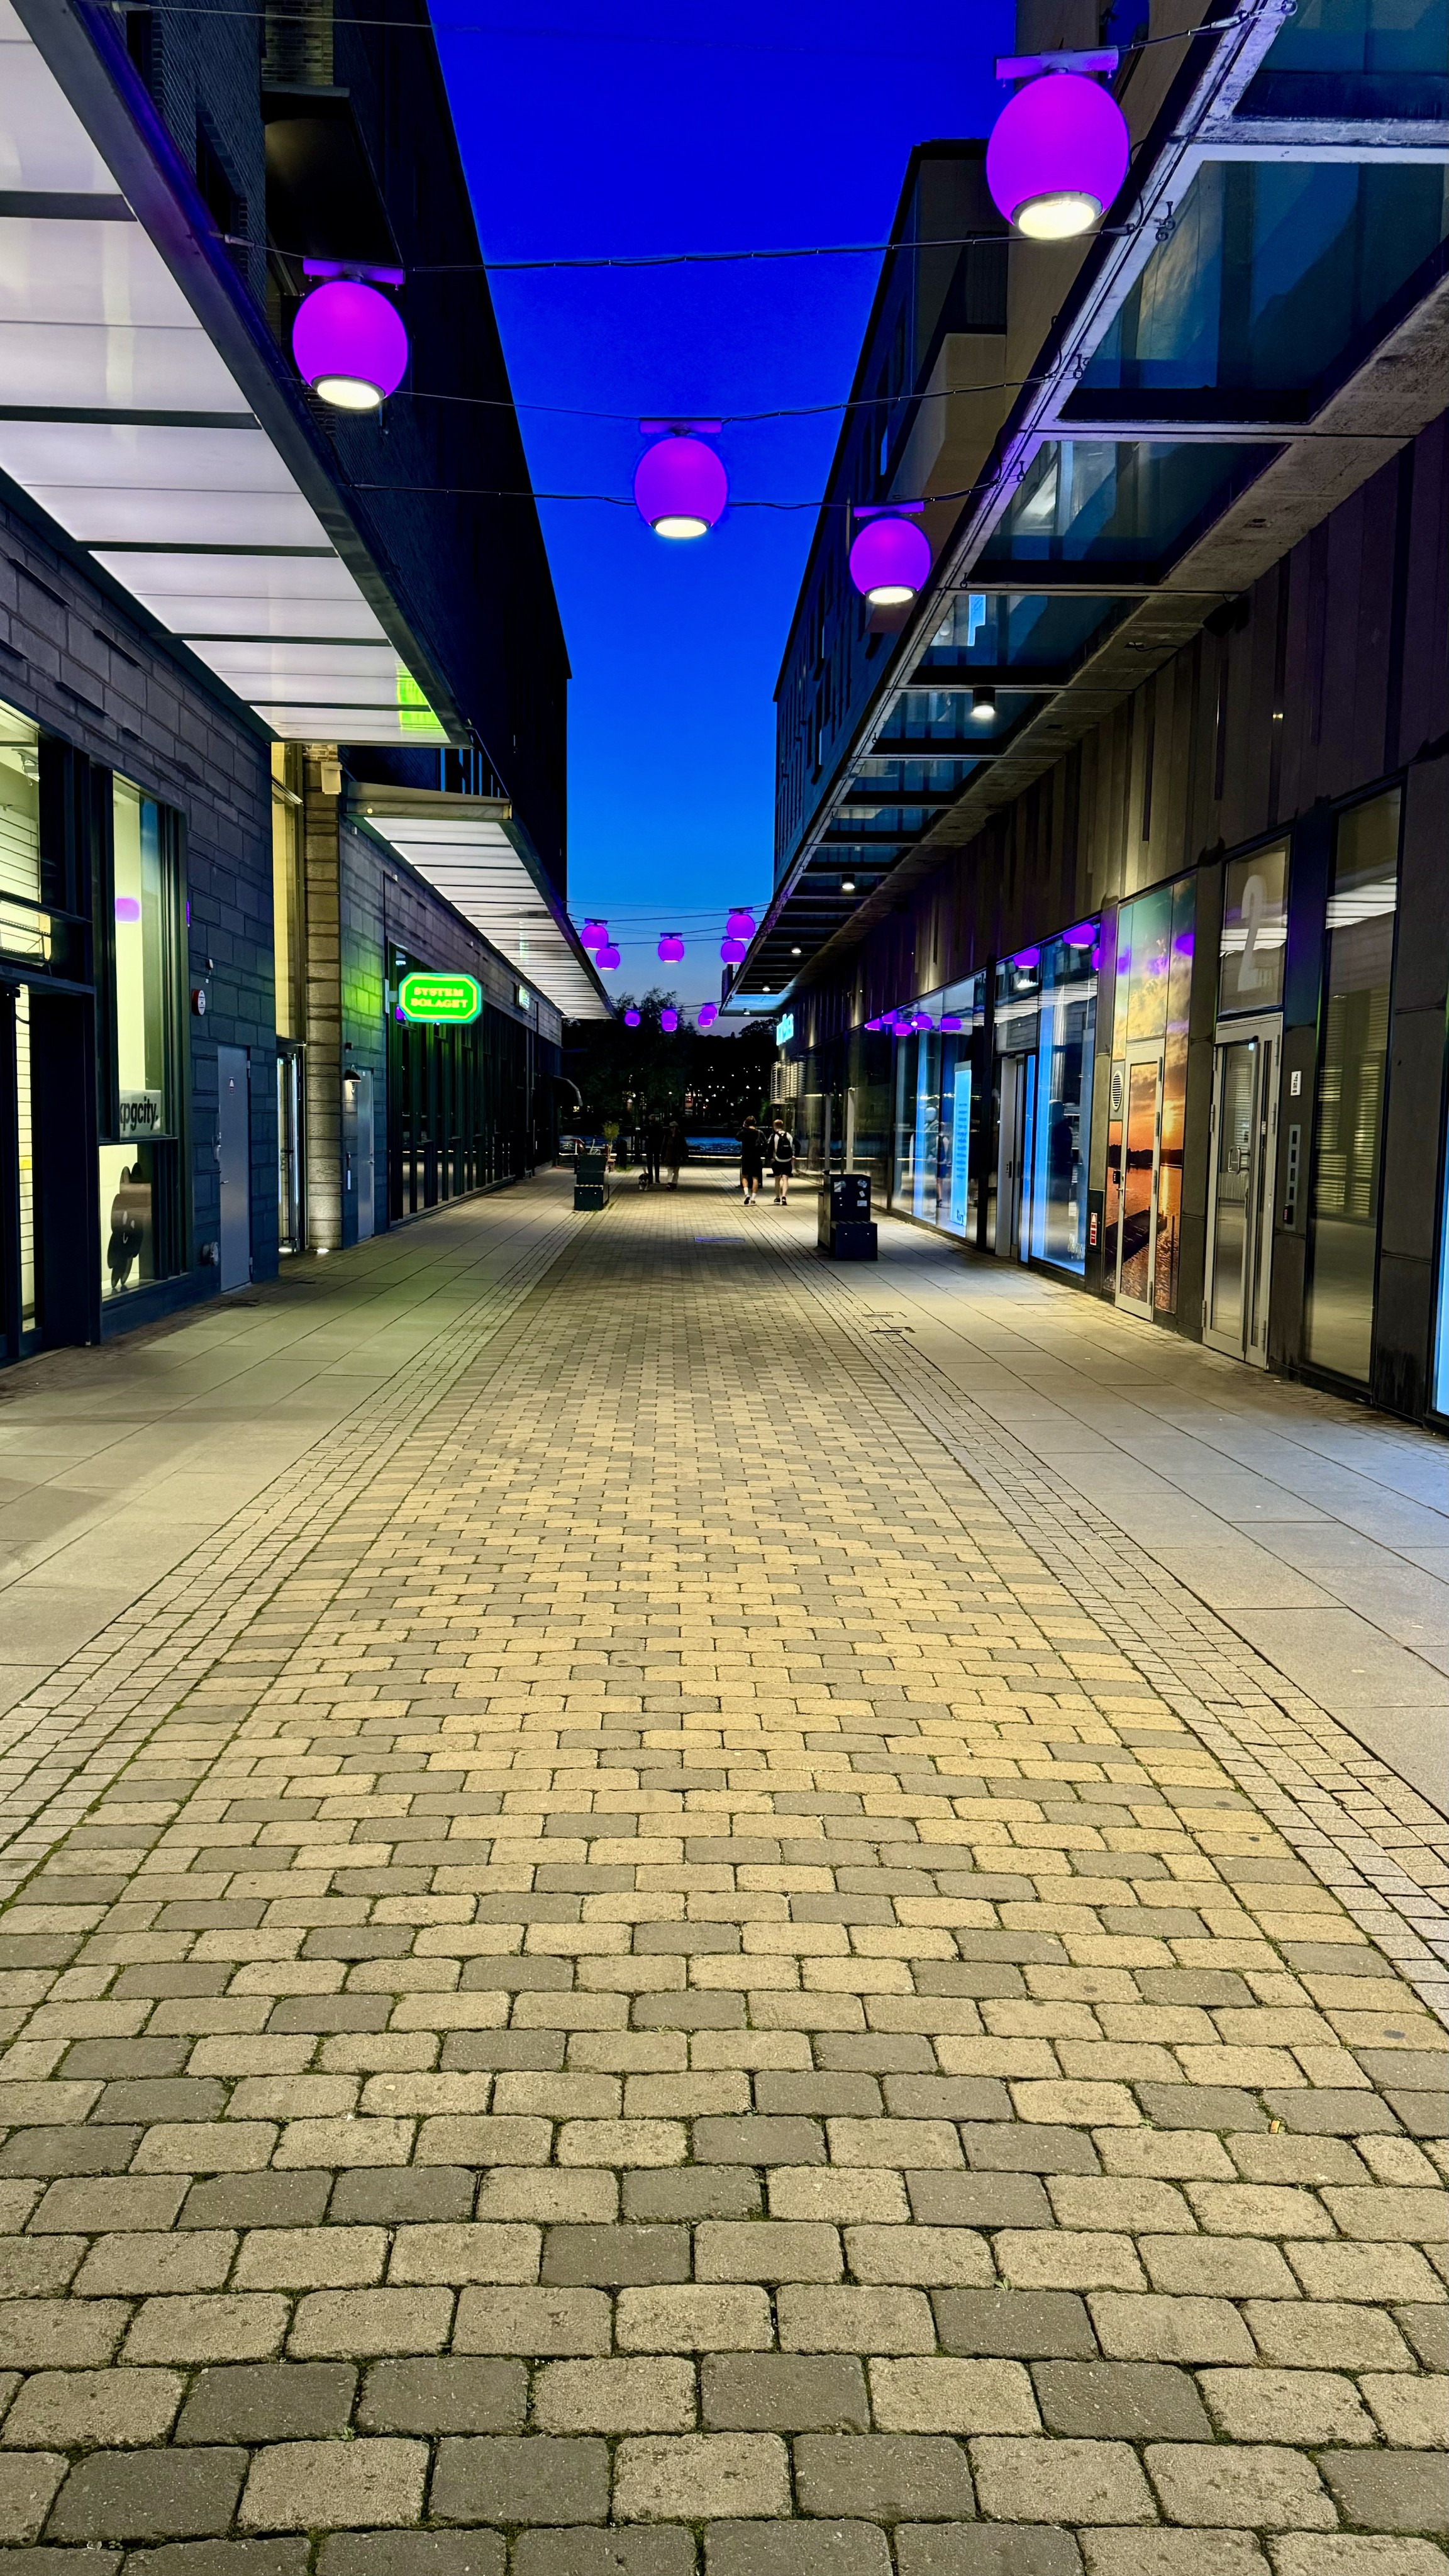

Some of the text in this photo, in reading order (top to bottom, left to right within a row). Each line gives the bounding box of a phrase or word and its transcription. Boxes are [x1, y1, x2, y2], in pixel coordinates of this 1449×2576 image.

[1237, 875, 1274, 992] 2
[413, 987, 464, 997] SYSTEM
[410, 998, 468, 1008] BOLAGET
